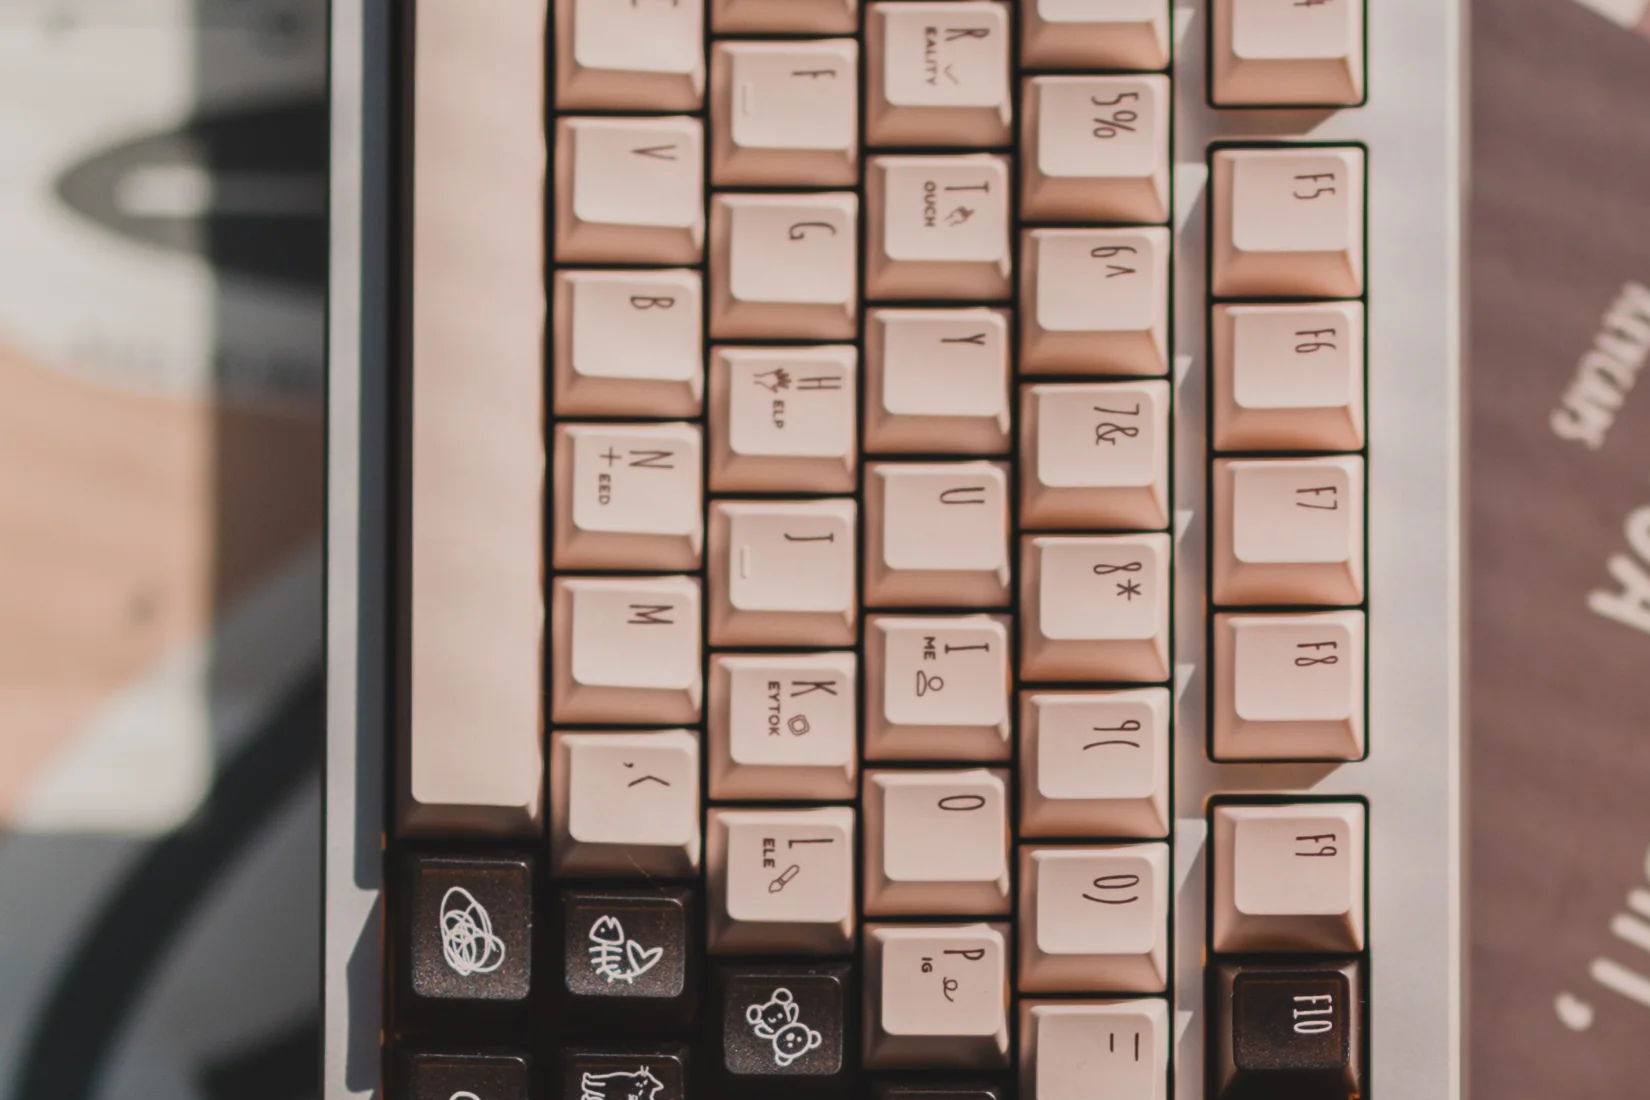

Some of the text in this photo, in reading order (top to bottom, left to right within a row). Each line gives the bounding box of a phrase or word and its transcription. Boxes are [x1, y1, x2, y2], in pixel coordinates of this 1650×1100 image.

[944, 27, 991, 42] R
[923, 26, 938, 87] EALITY
[629, 144, 678, 161] V
[944, 181, 990, 194] T
[1292, 172, 1336, 201] F5
[923, 181, 937, 228] OUCH
[787, 221, 837, 240] G
[629, 296, 675, 310] B
[940, 332, 987, 346] Y
[1294, 328, 1337, 354] F6
[796, 376, 843, 390] H
[772, 399, 785, 429] ELP
[1093, 403, 1140, 446] 7&
[628, 450, 675, 469] N
[598, 473, 611, 505] EED
[939, 486, 986, 505] U
[1295, 485, 1338, 511] F7
[783, 532, 835, 544] J
[627, 604, 675, 625] M
[922, 636, 937, 661] ME
[944, 642, 990, 654] I
[1294, 641, 1339, 667] F8
[790, 680, 838, 698] K
[767, 681, 781, 736] EYTOK
[762, 837, 776, 869] ELE
[787, 838, 835, 850] L
[1294, 833, 1338, 858] F9
[943, 948, 986, 961] P
[920, 957, 933, 974] IG
[1292, 994, 1333, 1034] F10
